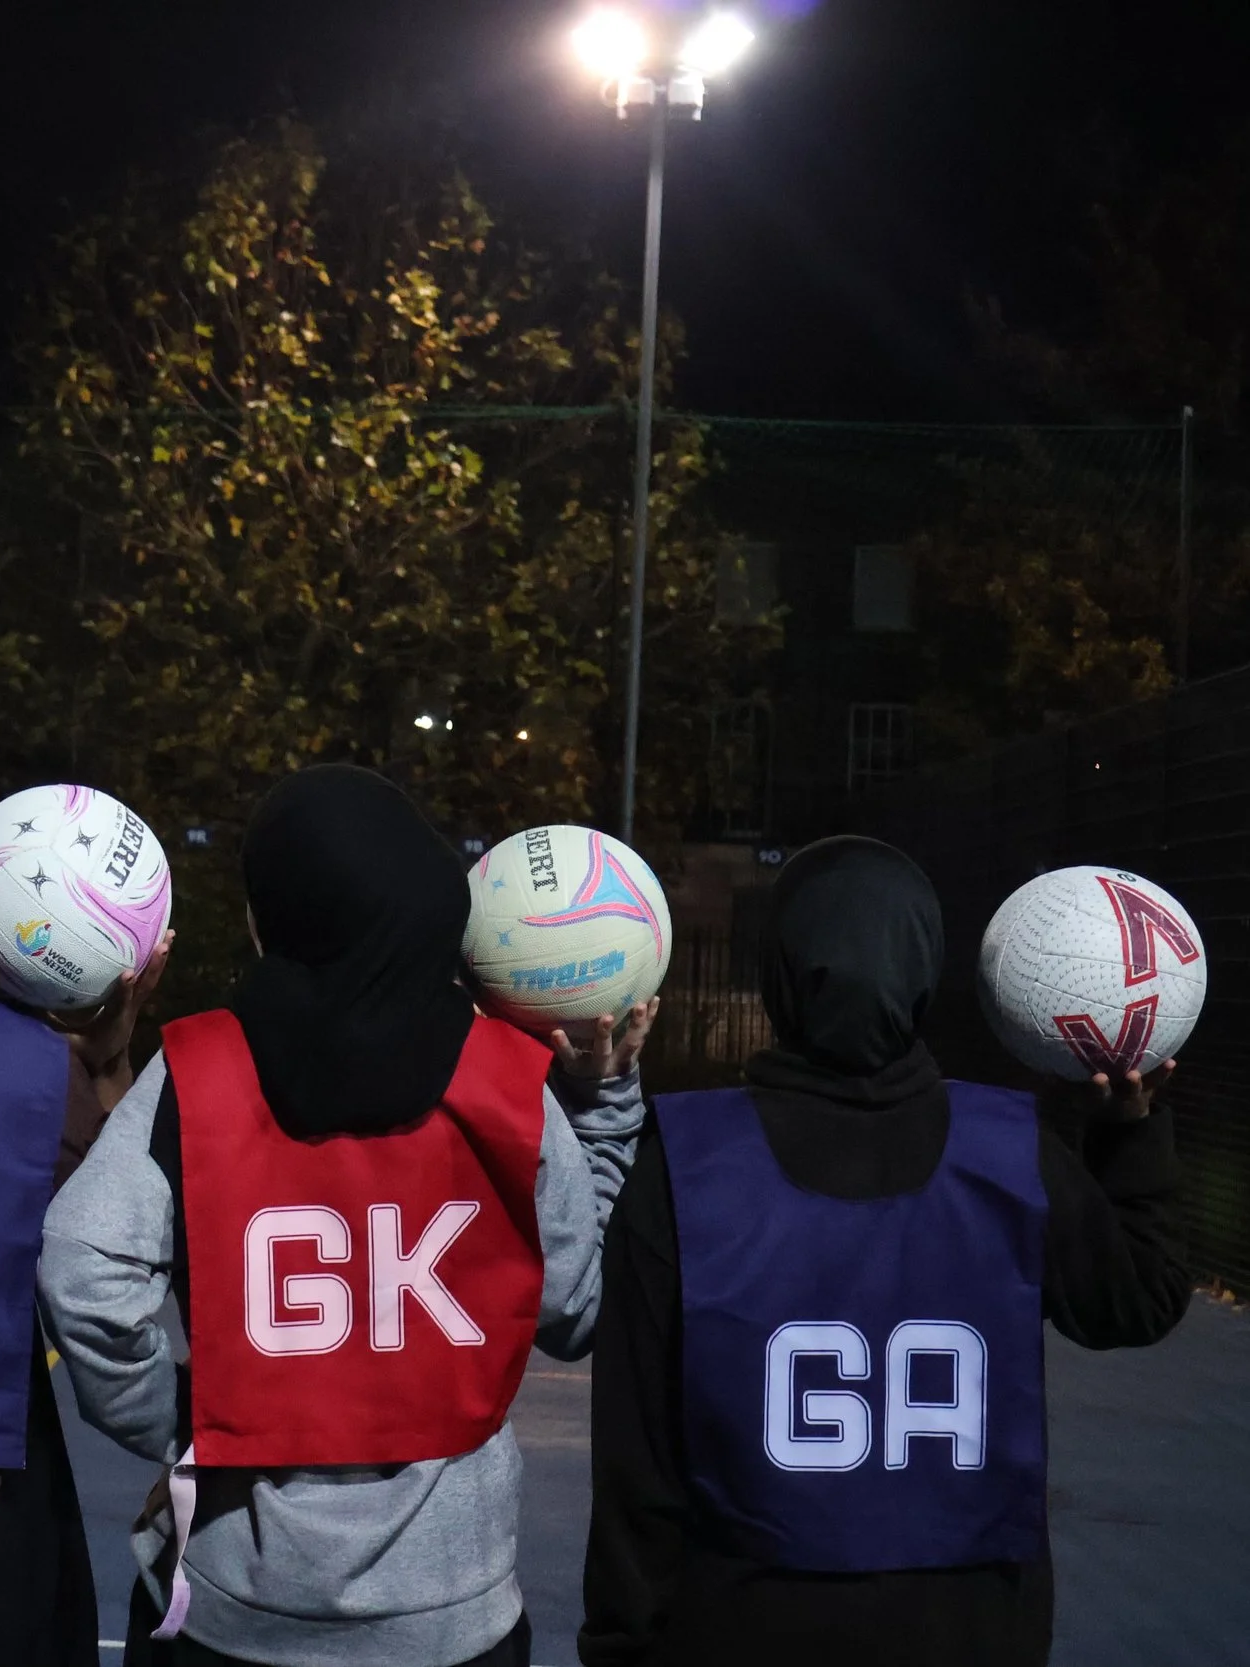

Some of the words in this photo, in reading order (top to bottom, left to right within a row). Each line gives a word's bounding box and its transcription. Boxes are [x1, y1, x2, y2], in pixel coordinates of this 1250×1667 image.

[42, 956, 80, 984] NETBALL
[48, 948, 83, 975] WORLD
[244, 1201, 486, 1357] GK
[764, 1320, 988, 1472] GA
